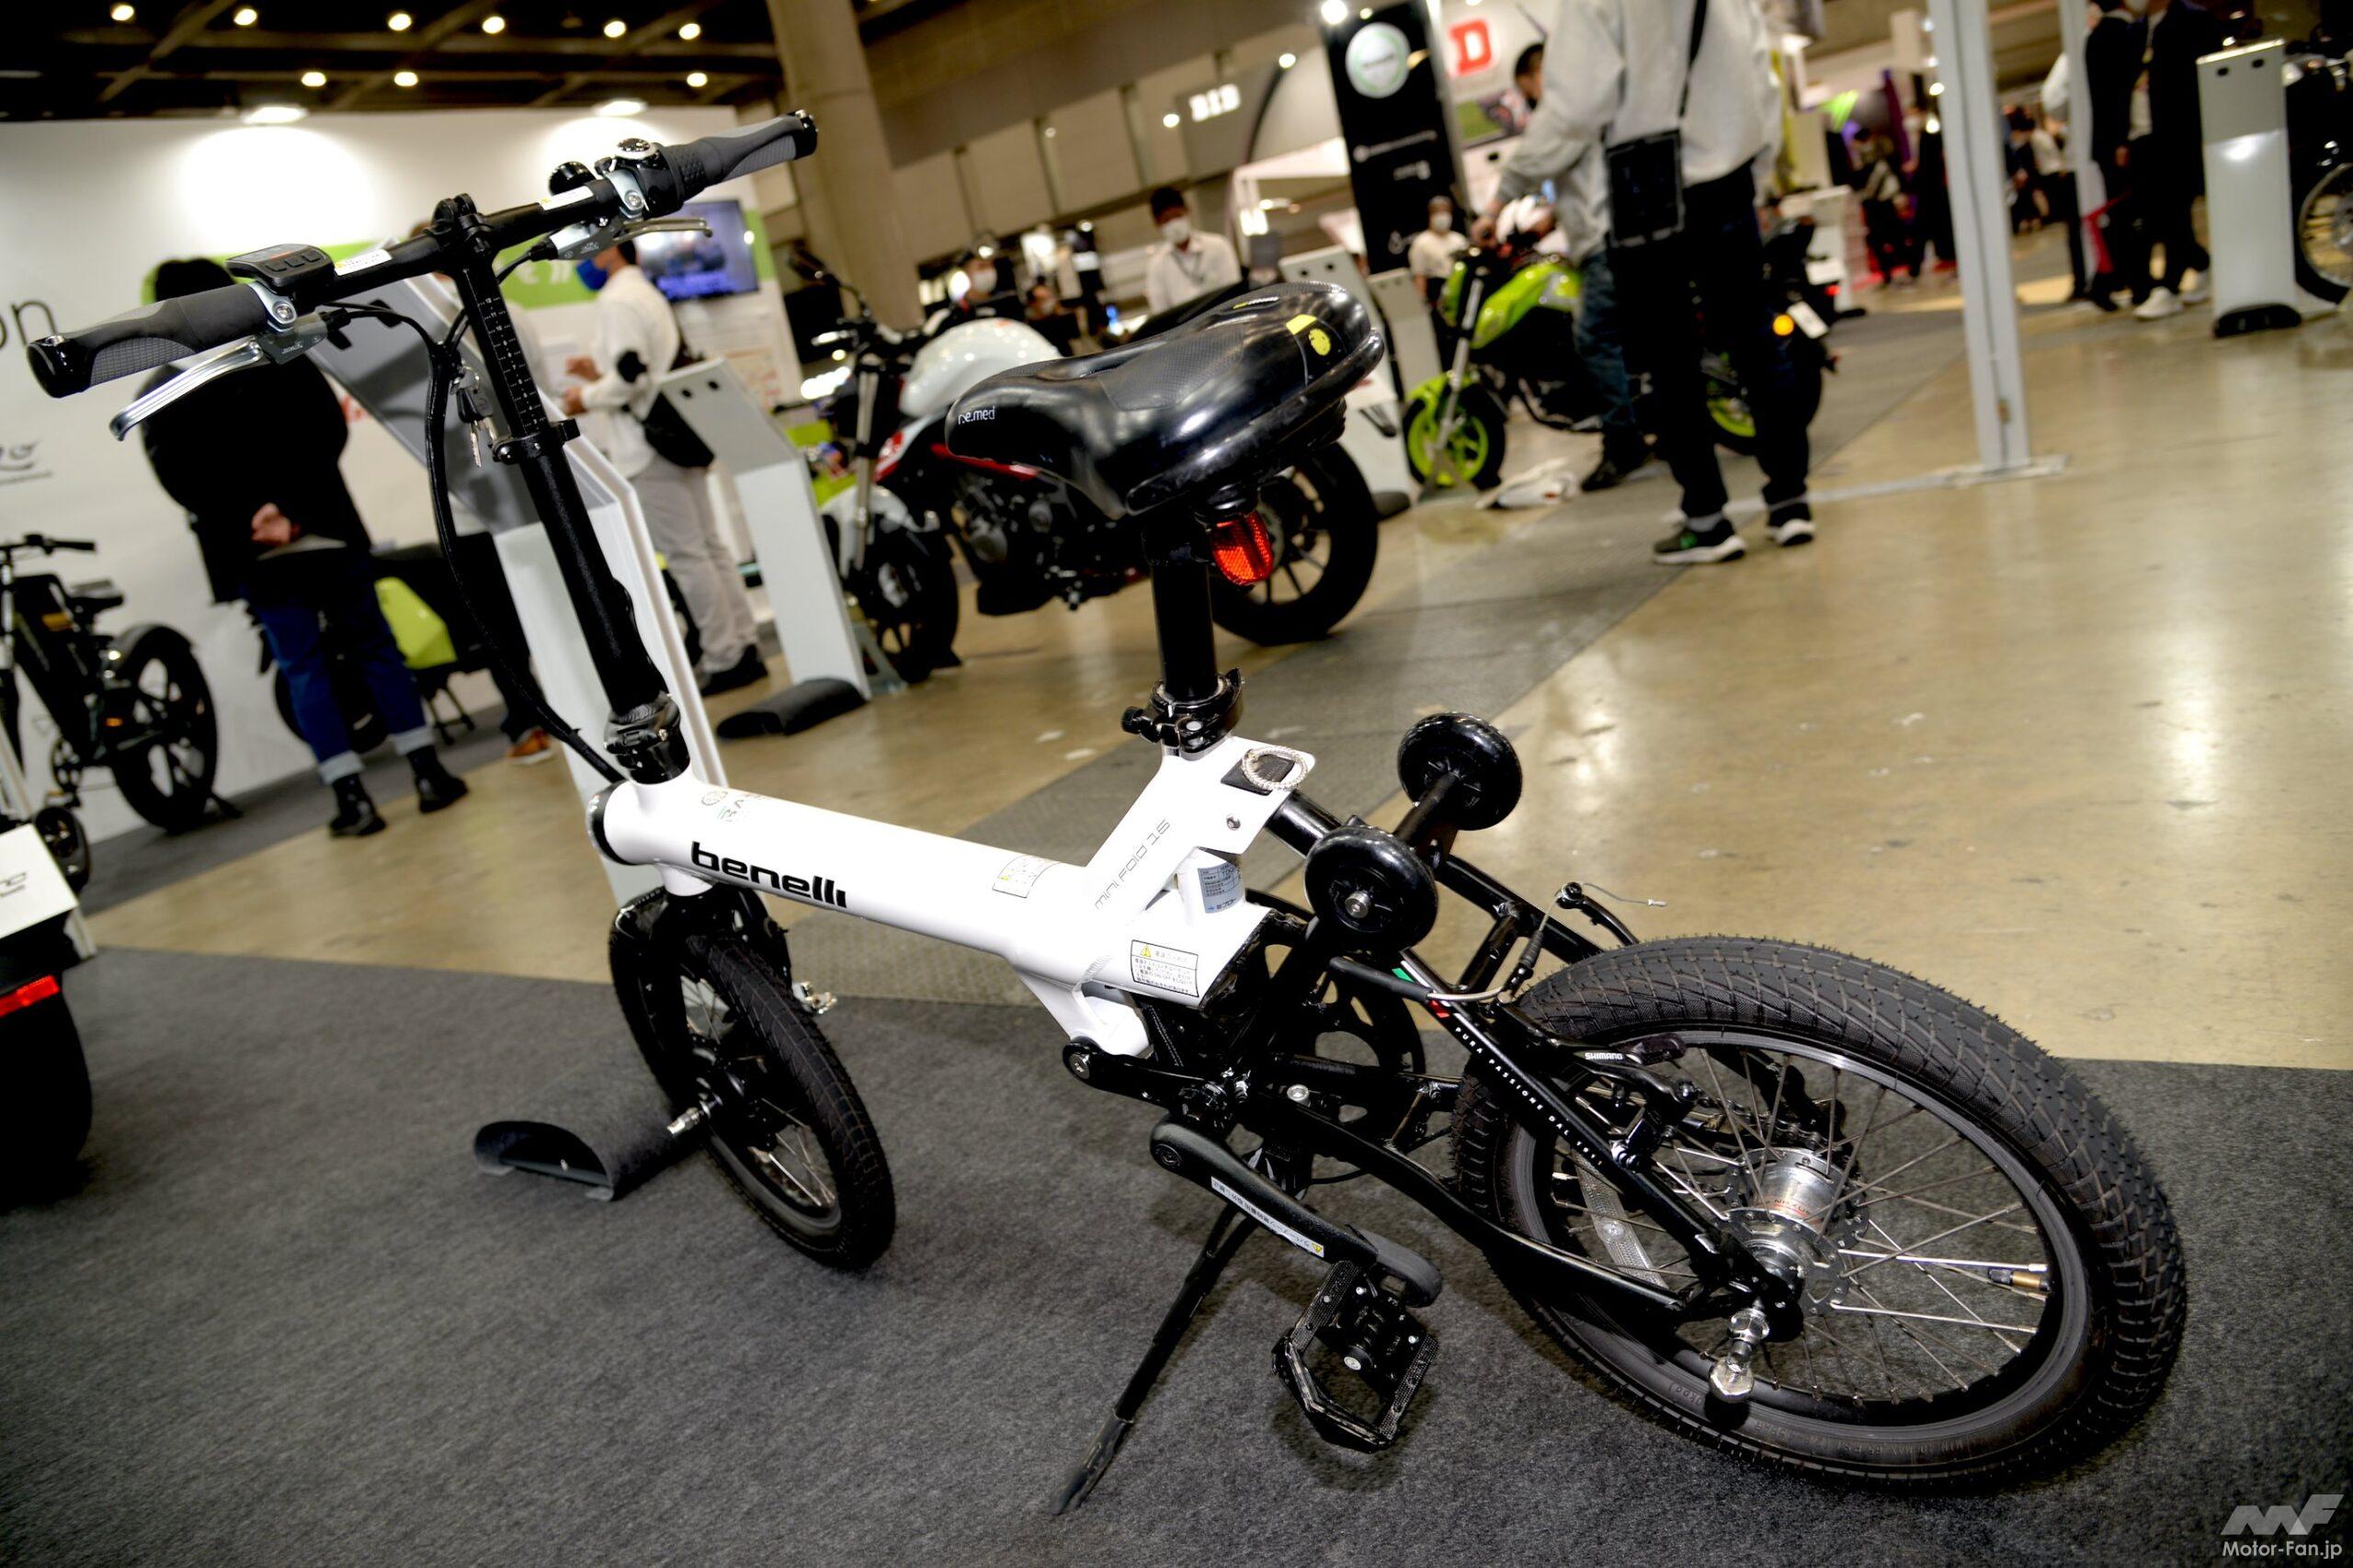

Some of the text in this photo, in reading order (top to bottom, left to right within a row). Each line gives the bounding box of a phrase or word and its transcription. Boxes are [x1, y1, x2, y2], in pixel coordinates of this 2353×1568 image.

[1146, 818, 1171, 846] 16
[691, 840, 847, 909] benelli
[1584, 1051, 1623, 1061] SHIMANO
[1455, 1027, 1483, 1054] PURA
[1488, 1058, 1544, 1110] PASSIONE
[1548, 1115, 1570, 1136] DAL
